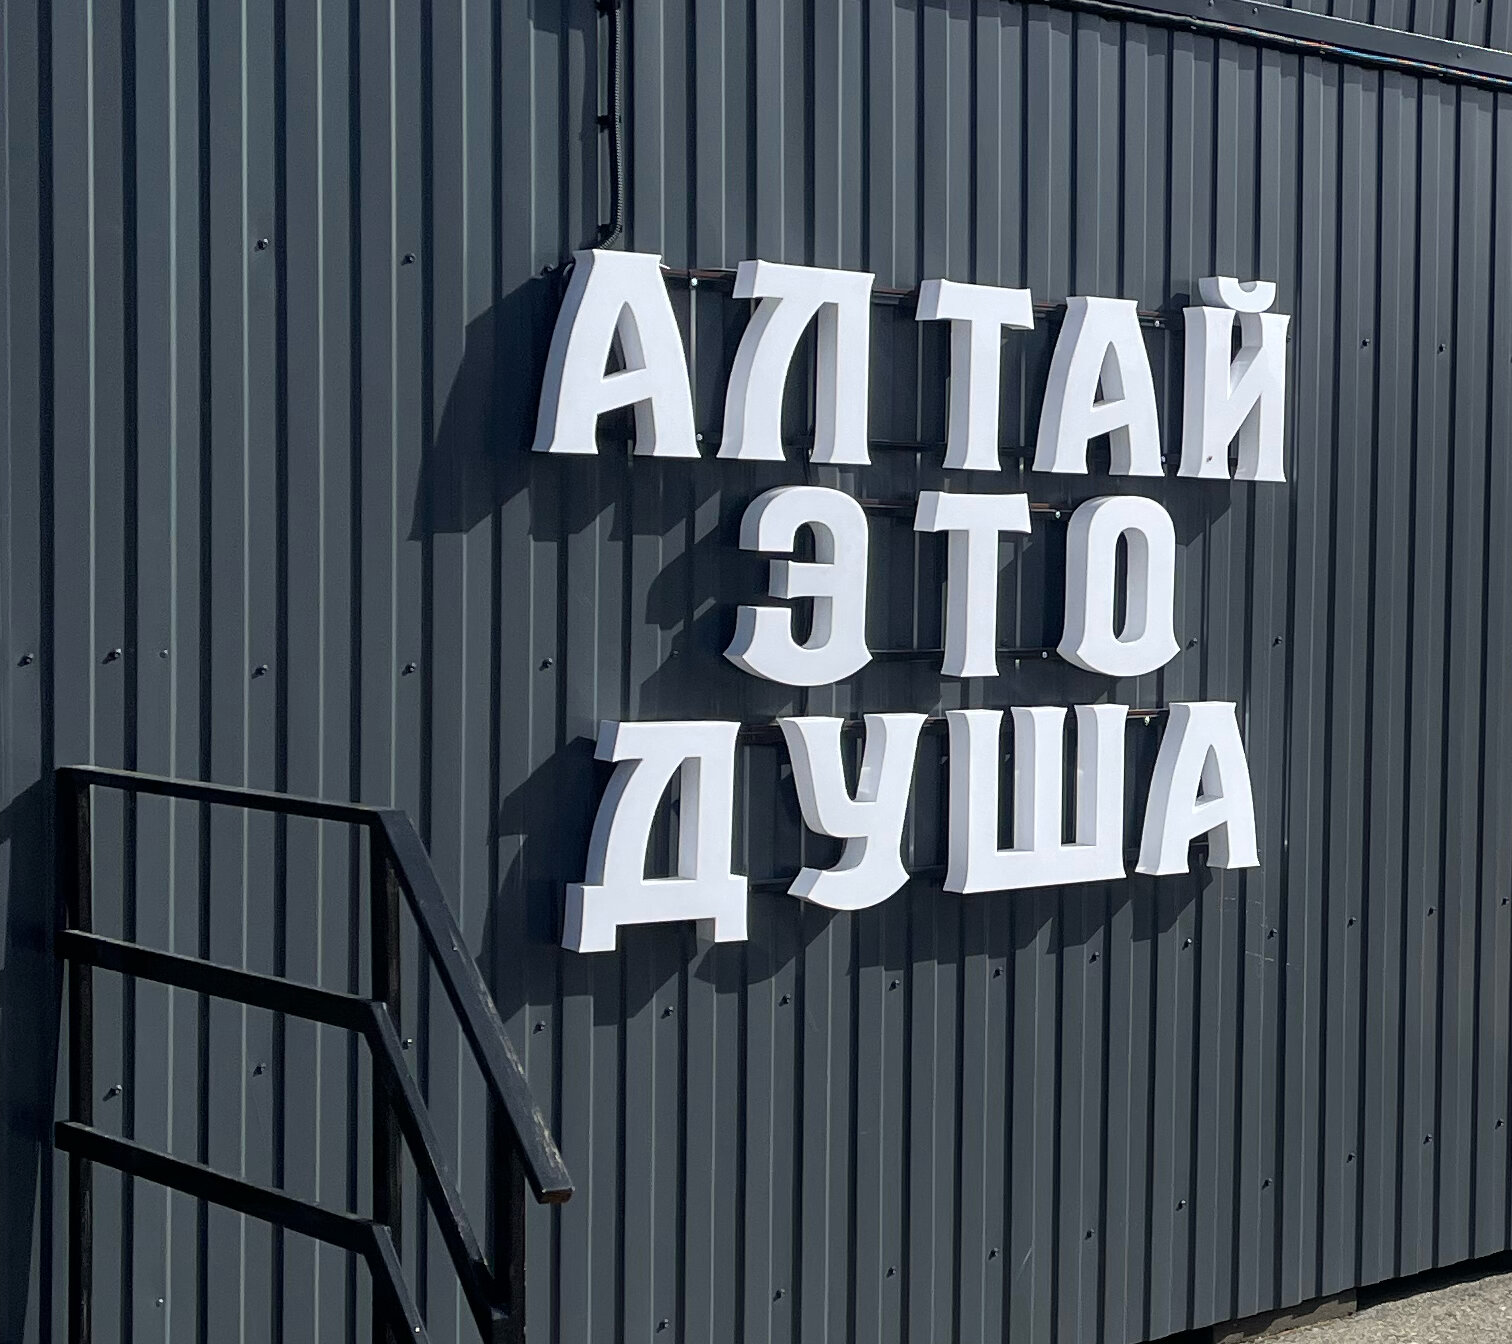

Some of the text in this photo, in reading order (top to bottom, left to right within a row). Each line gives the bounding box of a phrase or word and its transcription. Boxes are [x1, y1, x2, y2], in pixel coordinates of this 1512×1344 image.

[532, 249, 1291, 482] АЛТАЙ
[723, 485, 1181, 687] ЭТО
[561, 701, 1261, 954] ДУША
